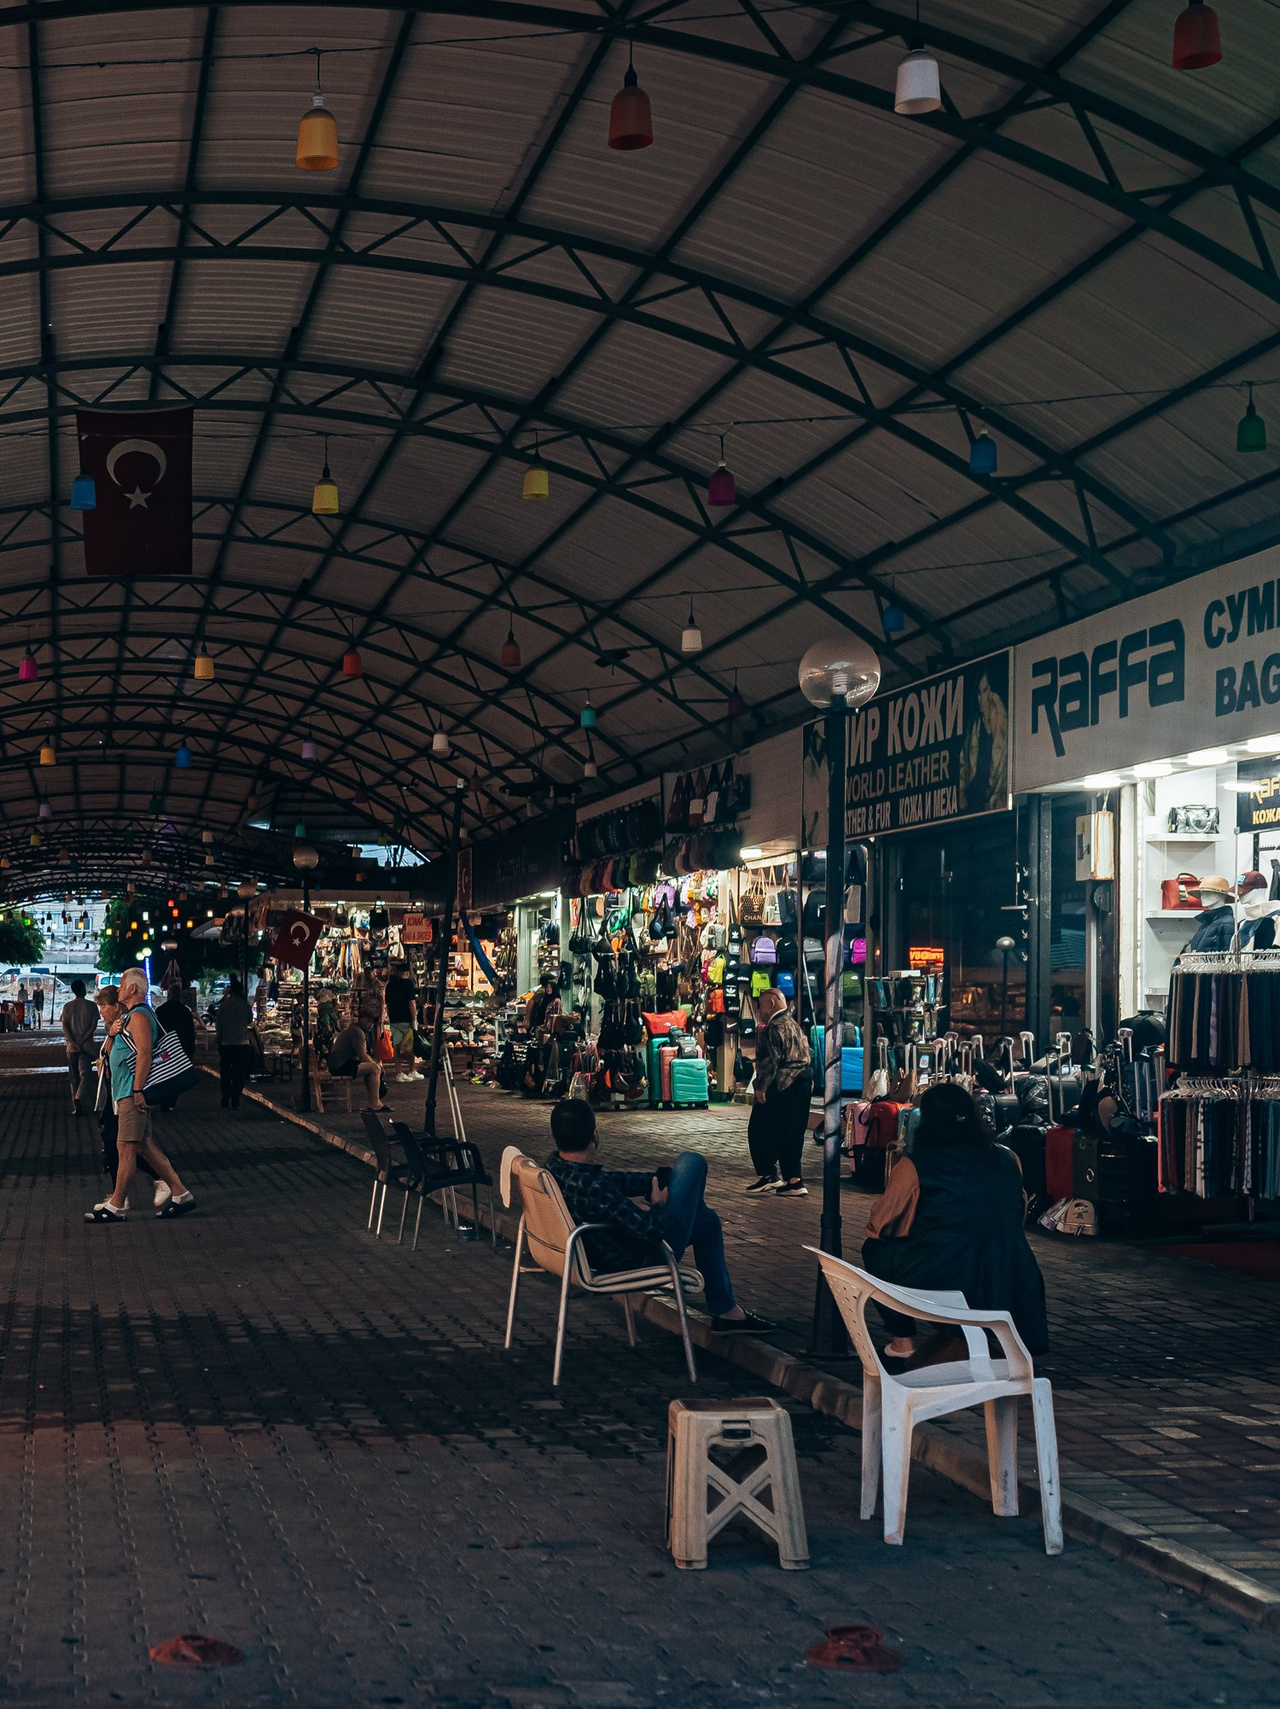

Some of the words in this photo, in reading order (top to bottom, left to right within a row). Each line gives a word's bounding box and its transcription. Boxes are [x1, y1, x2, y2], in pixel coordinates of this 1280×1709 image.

[886, 675, 965, 758] КОЖИ
[888, 749, 950, 794] LEATHER
[875, 800, 891, 830] FUR
[898, 793, 923, 826] КОЖА
[933, 785, 958, 819] МЕХА
